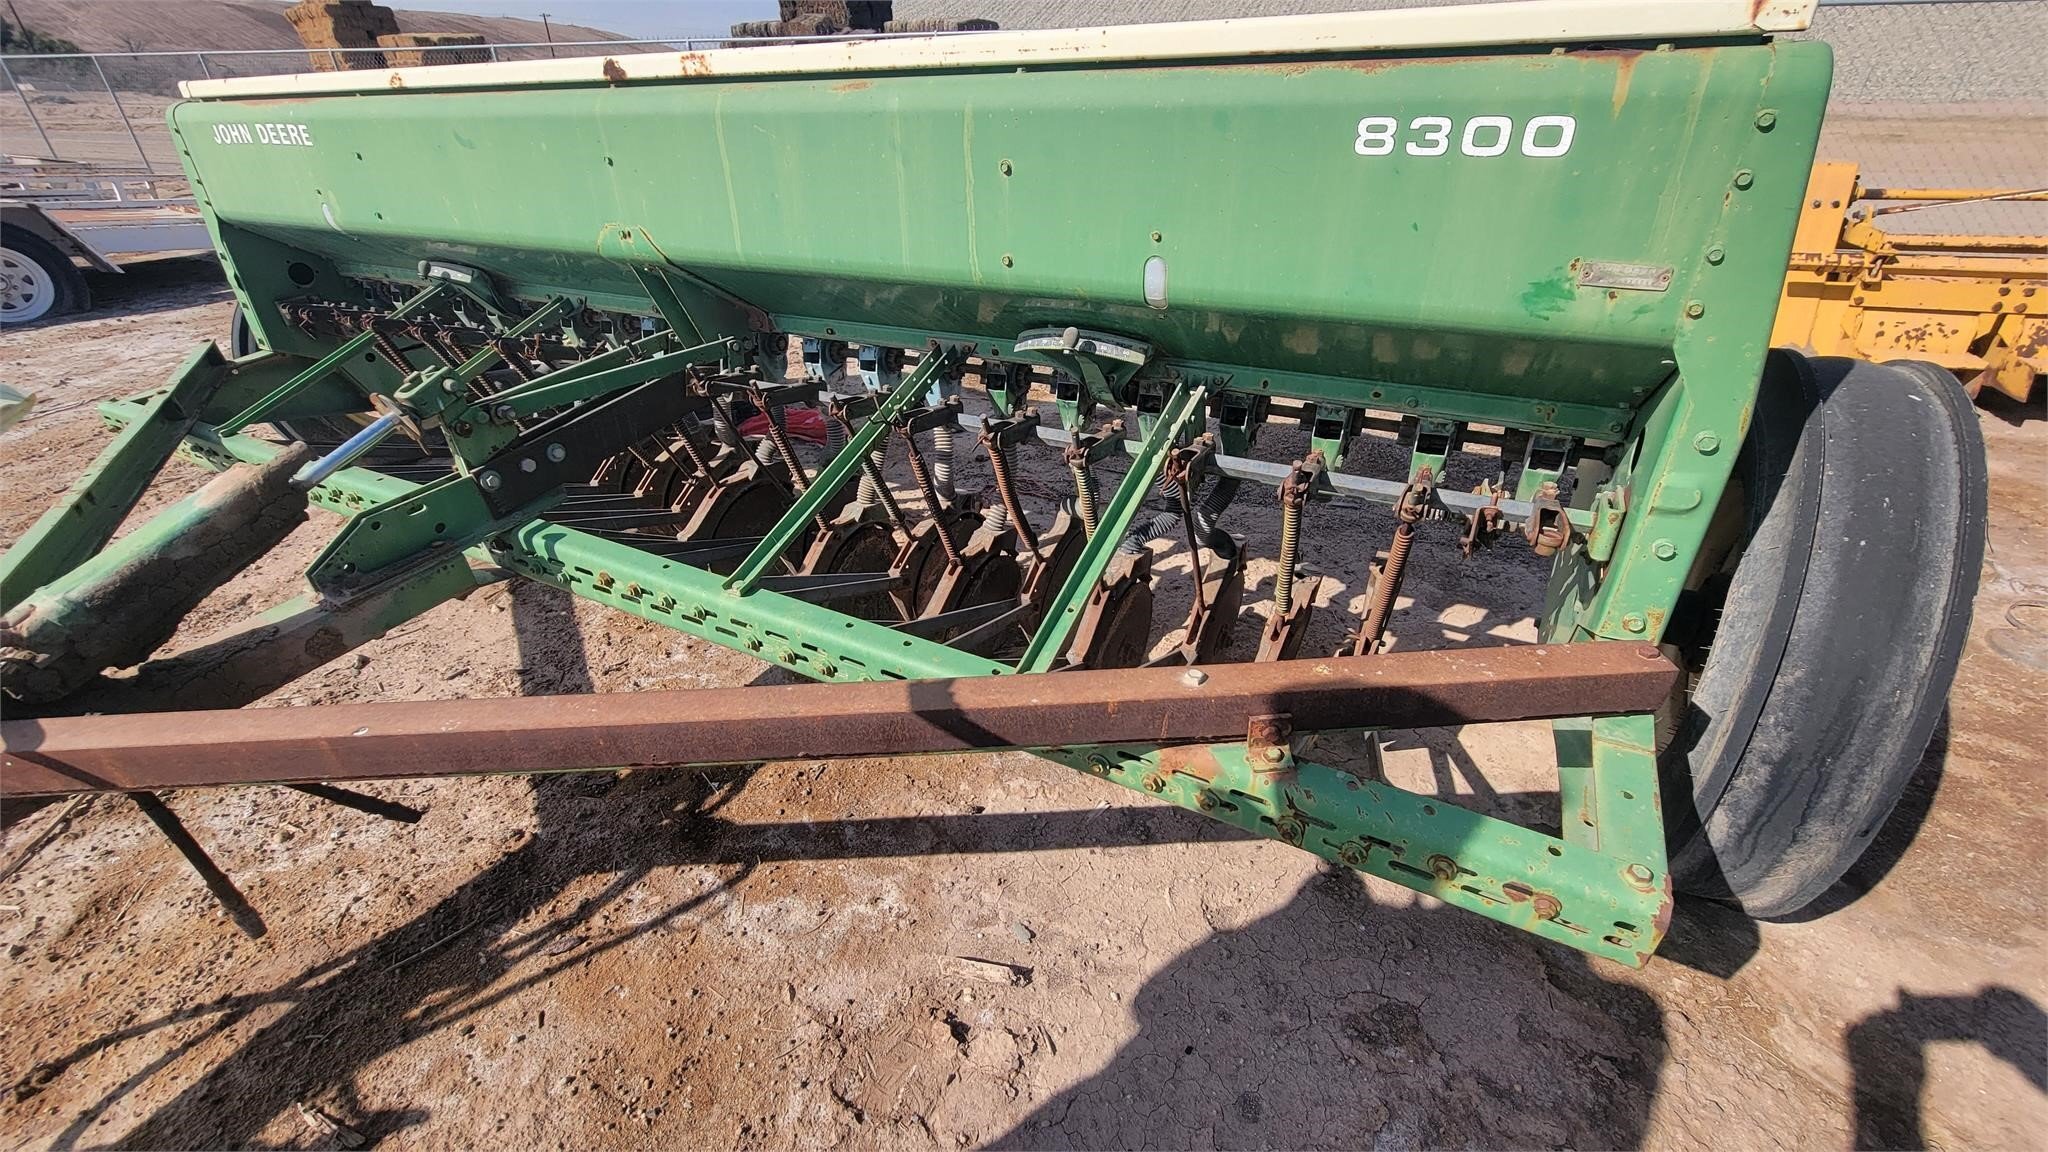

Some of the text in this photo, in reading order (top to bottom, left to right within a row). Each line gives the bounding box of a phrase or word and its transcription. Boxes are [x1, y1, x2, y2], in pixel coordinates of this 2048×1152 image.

[212, 123, 314, 146] JOHN DEERE
[1354, 115, 1577, 157] 8300
